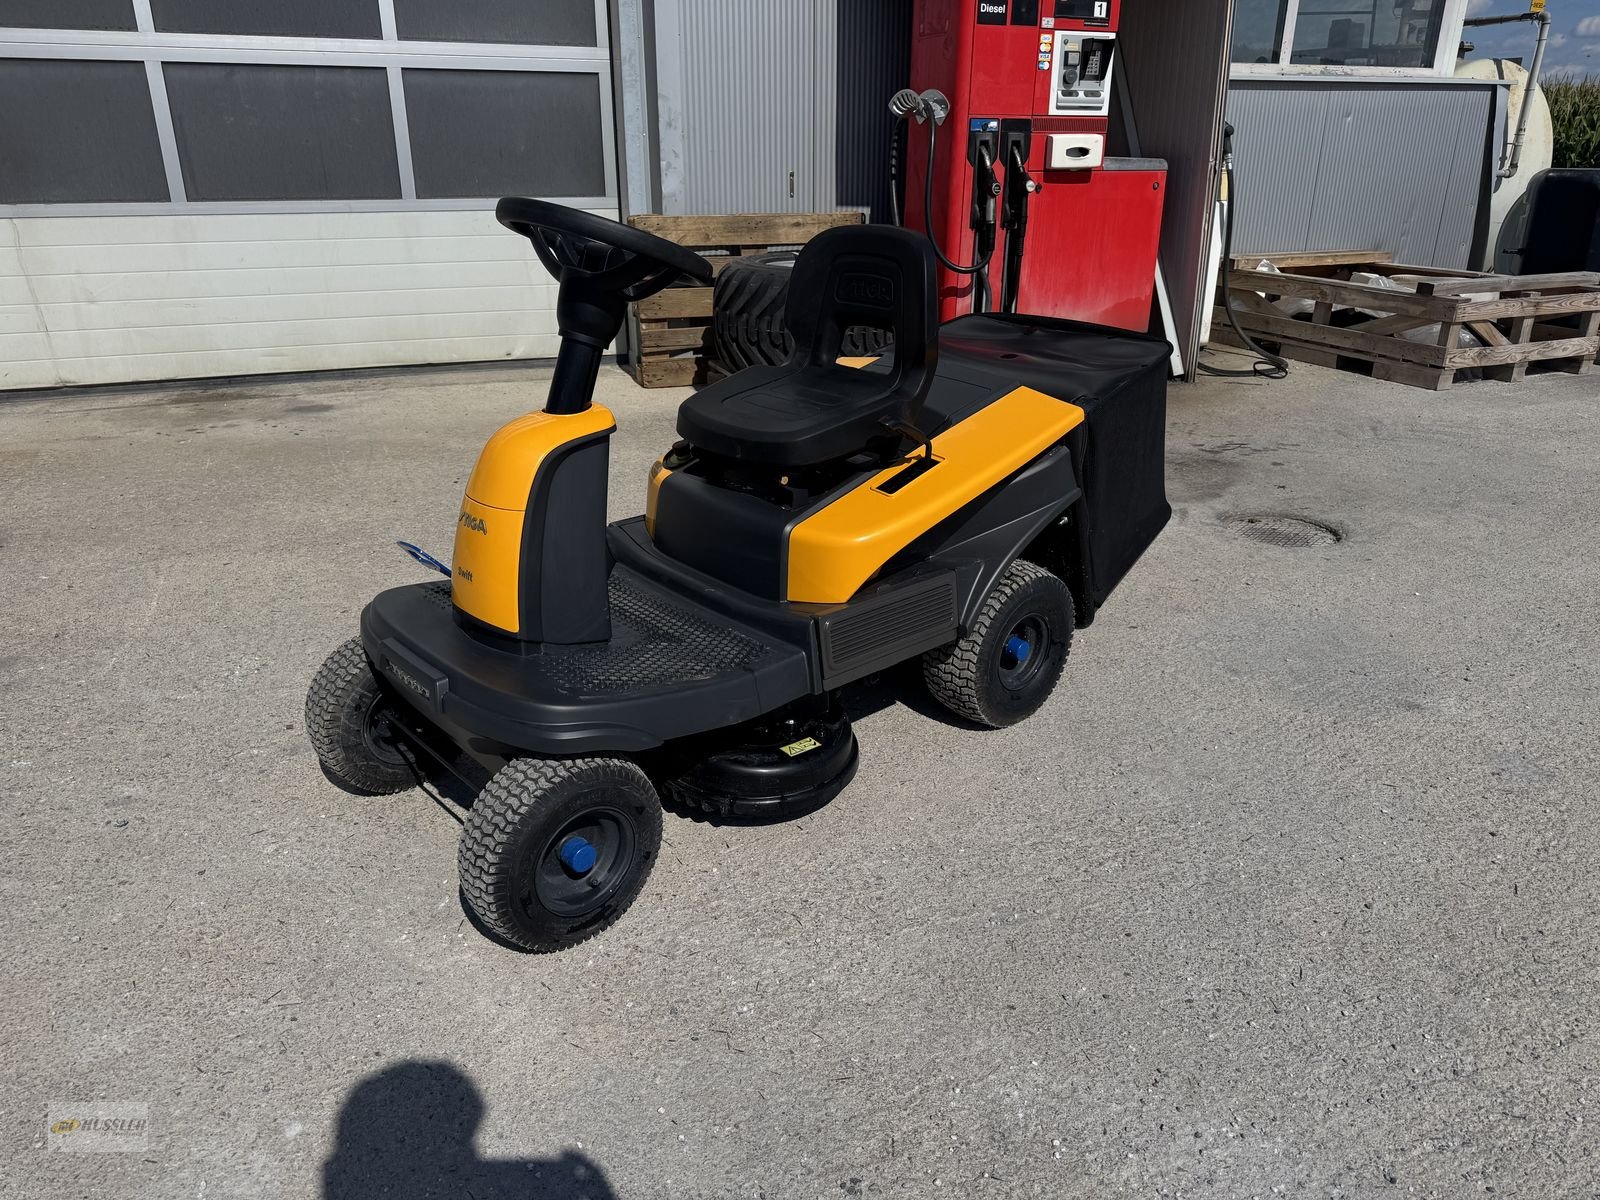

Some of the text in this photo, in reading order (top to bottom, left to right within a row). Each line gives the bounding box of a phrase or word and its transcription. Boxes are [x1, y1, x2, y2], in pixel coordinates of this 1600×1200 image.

[980, 3, 1006, 13] Diesel
[1097, 3, 1104, 16] 1
[458, 566, 473, 582] Swift
